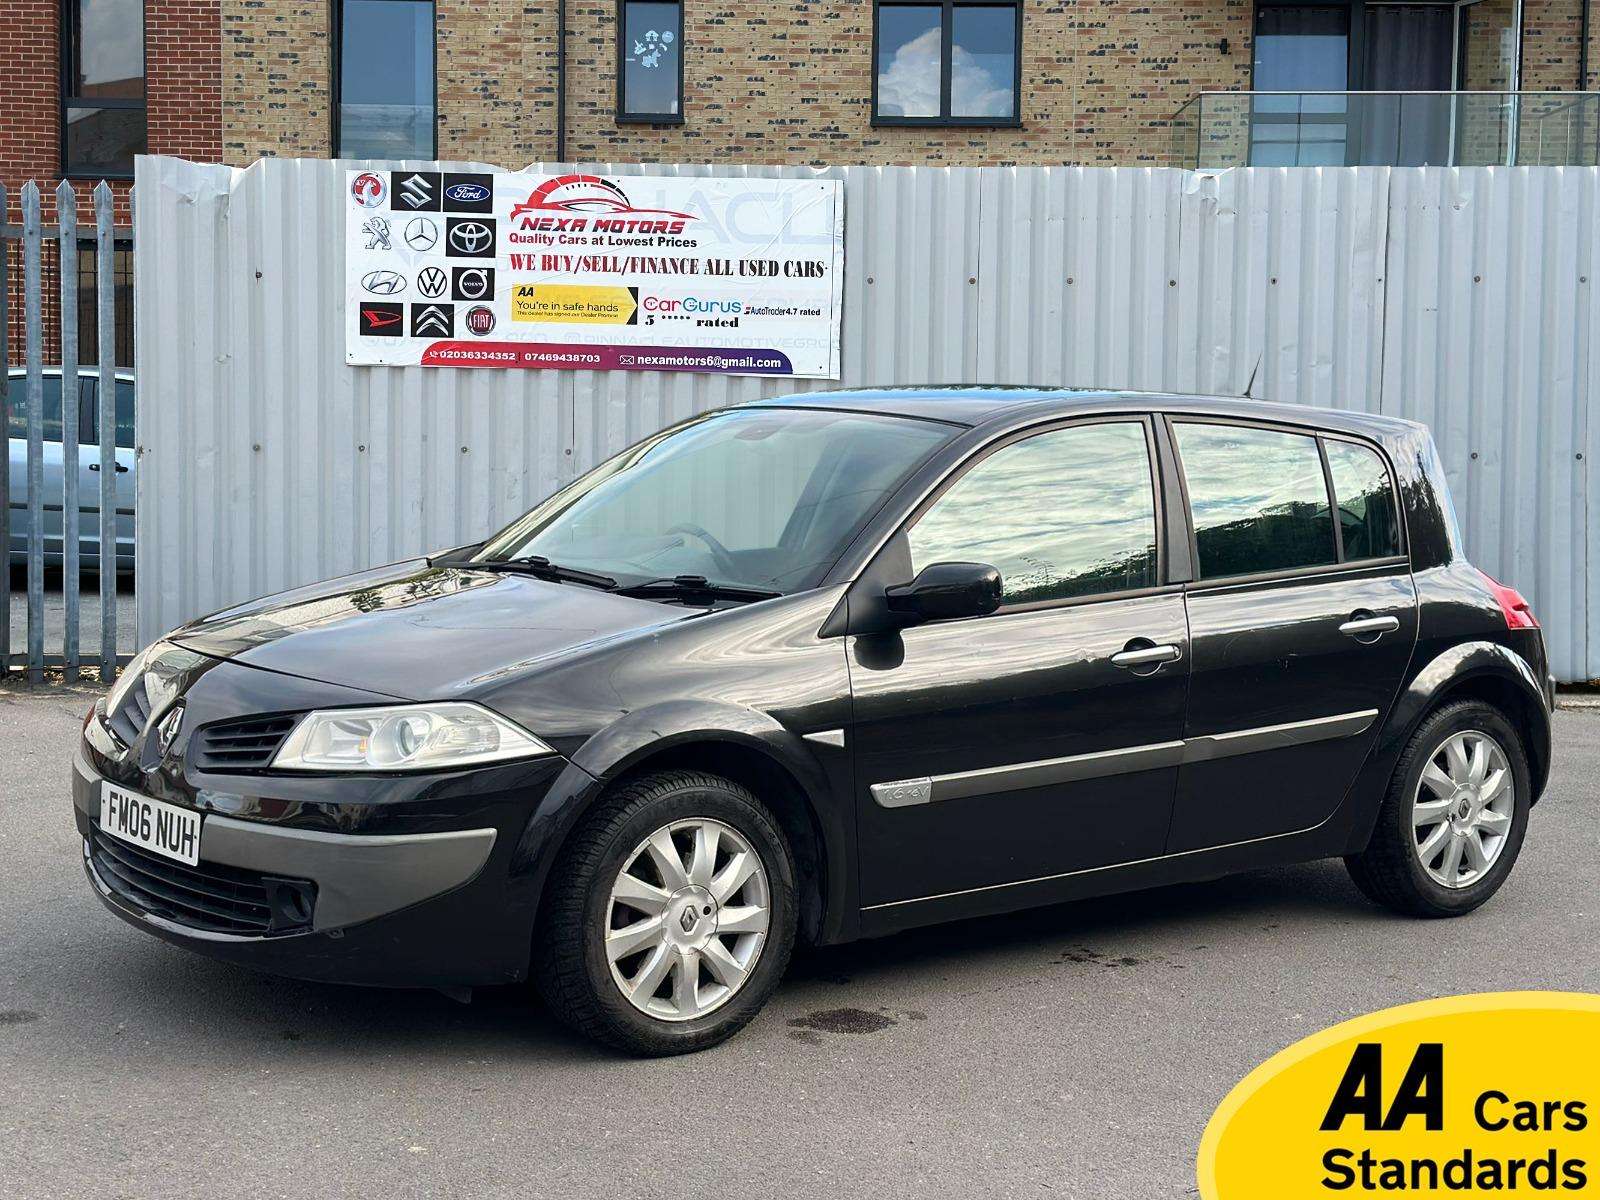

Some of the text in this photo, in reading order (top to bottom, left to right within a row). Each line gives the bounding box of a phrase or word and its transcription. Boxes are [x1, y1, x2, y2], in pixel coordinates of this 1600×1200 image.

[454, 186, 481, 199] Ford
[520, 216, 686, 235] NEXA MOTORS
[509, 233, 697, 248] Quality Cars at Lowest Prices
[509, 253, 824, 278] WE BUY/SELL/FINANCE ALL USED CARS
[517, 286, 534, 297] AA
[516, 300, 619, 312] You're in safe hands
[643, 296, 742, 313] CarGurus
[799, 308, 821, 316] rated
[473, 314, 490, 325] FIAT
[645, 314, 739, 328] 5 rated
[440, 350, 601, 363] 02036334352 07469438703
[637, 355, 782, 369] nexamotors6@gmail.com
[109, 791, 195, 859] FM06 NUH
